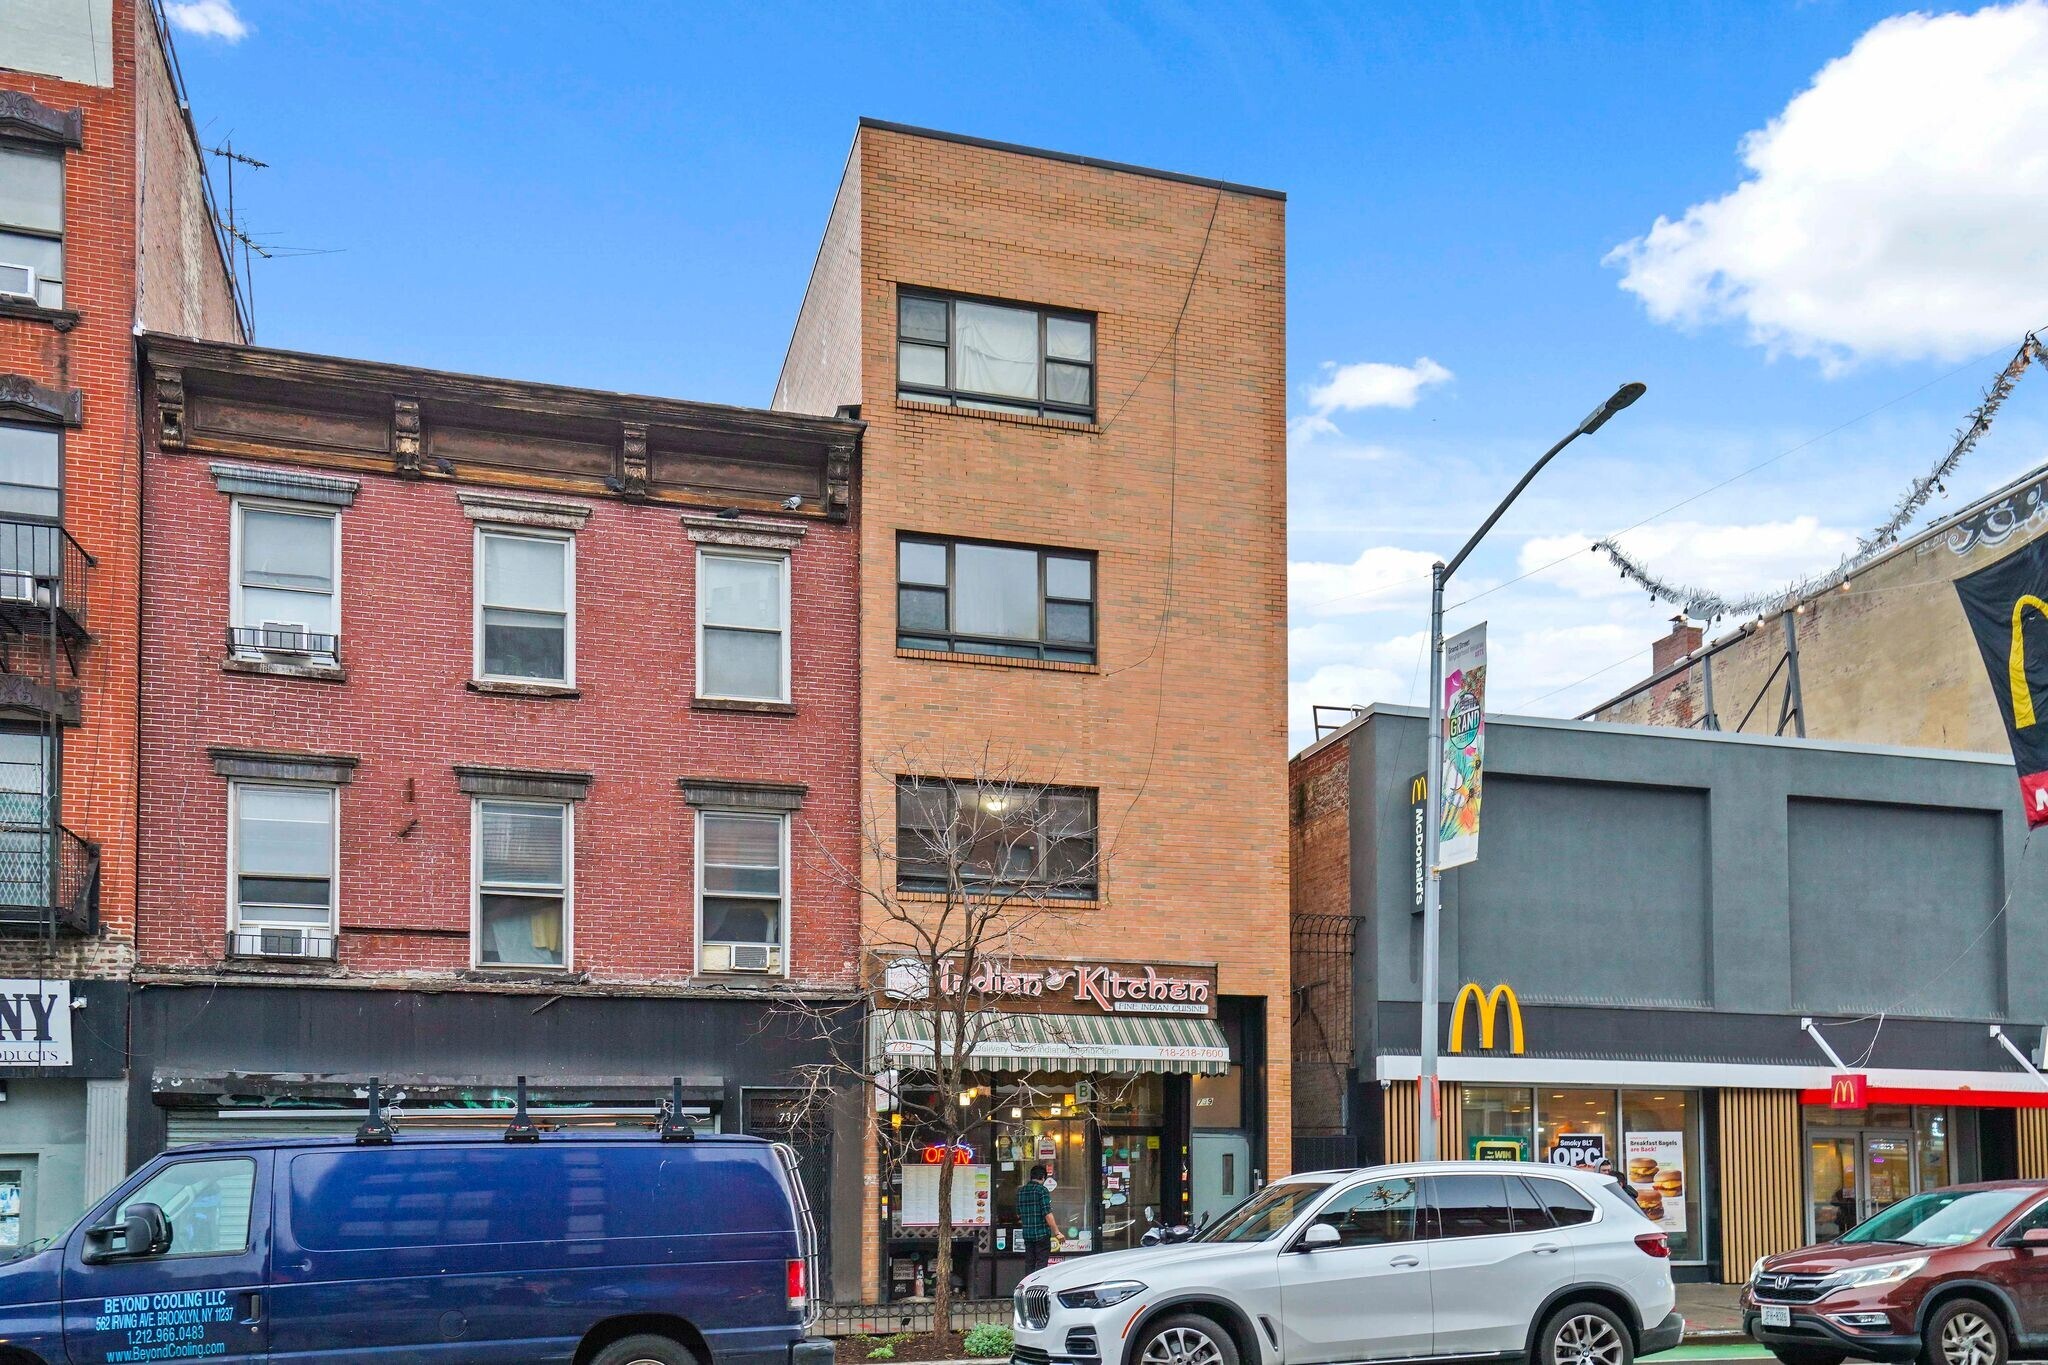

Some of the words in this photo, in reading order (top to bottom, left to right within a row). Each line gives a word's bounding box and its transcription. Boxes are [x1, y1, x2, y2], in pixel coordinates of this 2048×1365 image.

[1450, 709, 1480, 738] GRAND
[1415, 808, 1424, 906] McDonald's
[1073, 965, 1211, 1012] Kitchen
[1118, 1003, 1138, 1011] FINE
[1141, 1004, 1169, 1012] INDIAN
[1171, 1004, 1206, 1013] CUISINE
[893, 1042, 912, 1052] 739
[1158, 1048, 1224, 1058] 718-218-7600
[0, 1050, 58, 1061] DUCTS
[778, 1112, 798, 1124] 737
[1560, 1139, 1582, 1148] Smoky
[1494, 1150, 1512, 1159] WIN
[104, 1296, 150, 1314] BEYOND
[153, 1292, 203, 1310] COOLING
[205, 1290, 226, 1306] LLC
[111, 1312, 138, 1330] IRVING
[201, 1307, 214, 1323] NY
[214, 1306, 234, 1322] 11237
[127, 1325, 205, 1345] 1.212.966.0483
[106, 1342, 226, 1363] www.BeyondCooling.com
